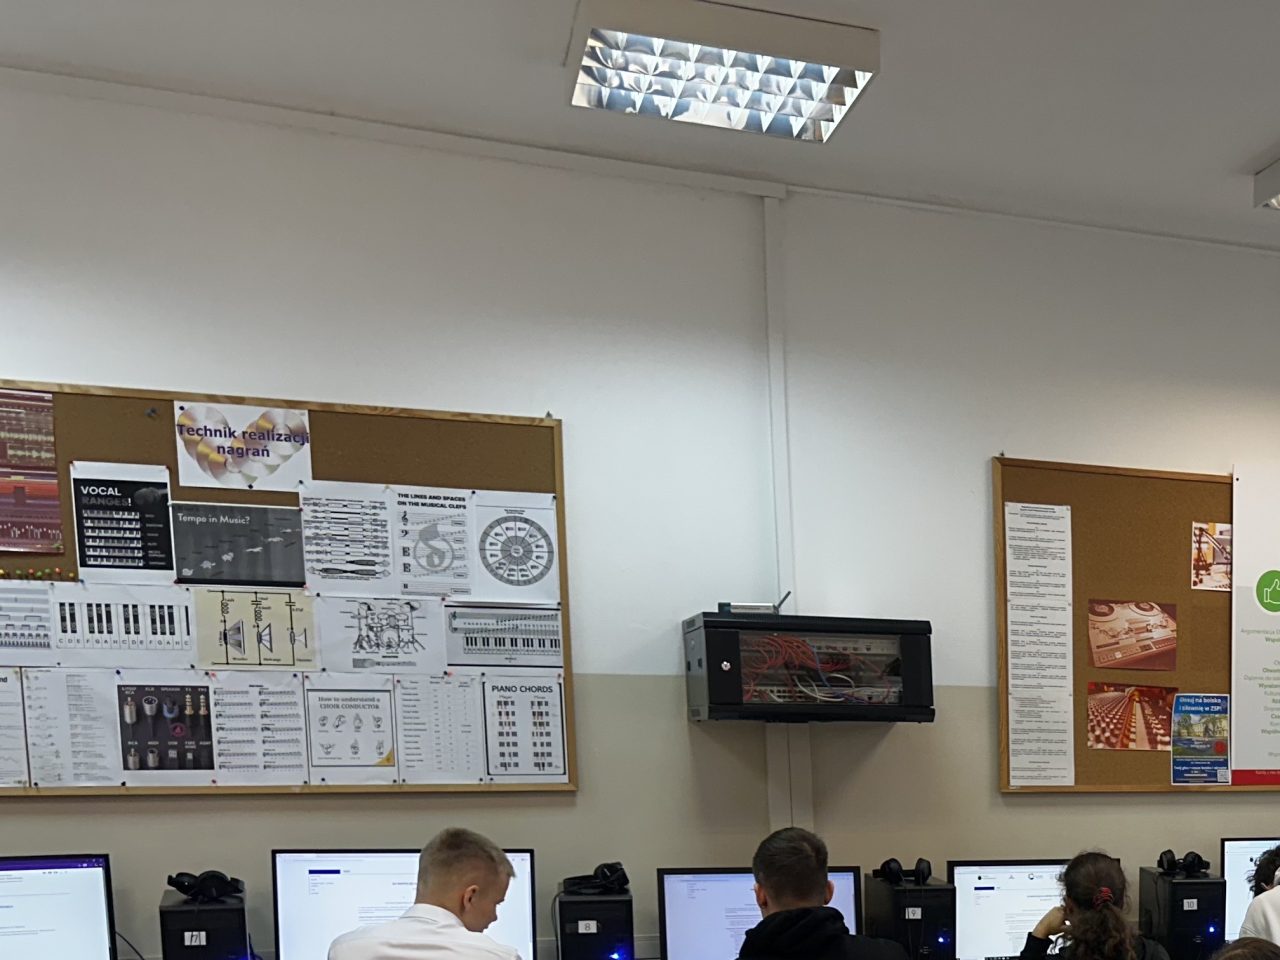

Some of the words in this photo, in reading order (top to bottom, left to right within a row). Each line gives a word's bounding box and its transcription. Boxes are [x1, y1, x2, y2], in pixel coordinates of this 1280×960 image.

[176, 423, 237, 439] Technik
[241, 429, 310, 445] realizacji
[217, 445, 270, 458] nagrań
[80, 485, 122, 496] VOCAL
[82, 496, 132, 507] RANGES!
[177, 513, 207, 525] Tempo
[209, 514, 218, 523] in
[220, 515, 250, 524] Music?
[491, 685, 518, 693] PIANO
[519, 685, 554, 693] CHORDS
[1186, 900, 1195, 909] 10
[584, 922, 591, 931] 8
